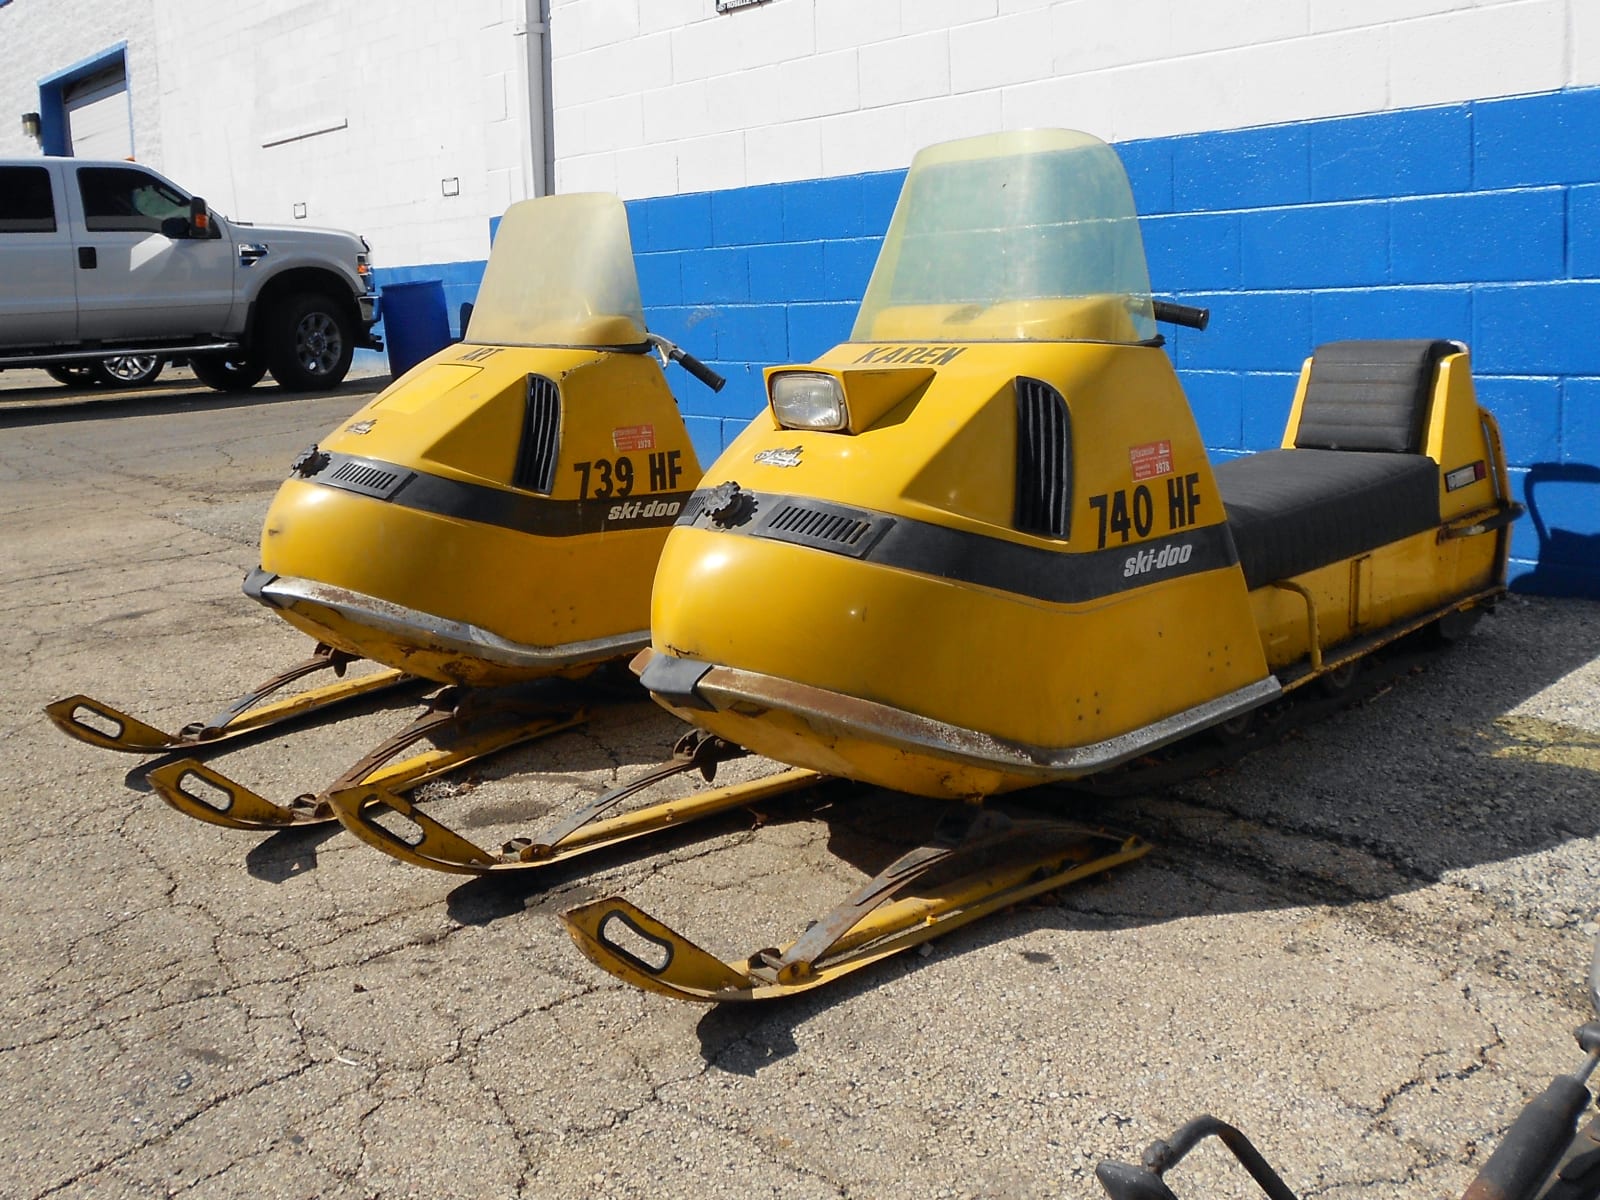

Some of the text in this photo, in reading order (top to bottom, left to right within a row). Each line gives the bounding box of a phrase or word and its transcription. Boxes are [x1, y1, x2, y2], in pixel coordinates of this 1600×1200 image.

[852, 347, 968, 365] KAREN
[573, 450, 682, 500] 739 HF
[1155, 461, 1170, 474] 1978
[608, 500, 680, 520] ski-doo
[1089, 472, 1200, 549] 740 HF
[1123, 544, 1192, 577] ski-doo
